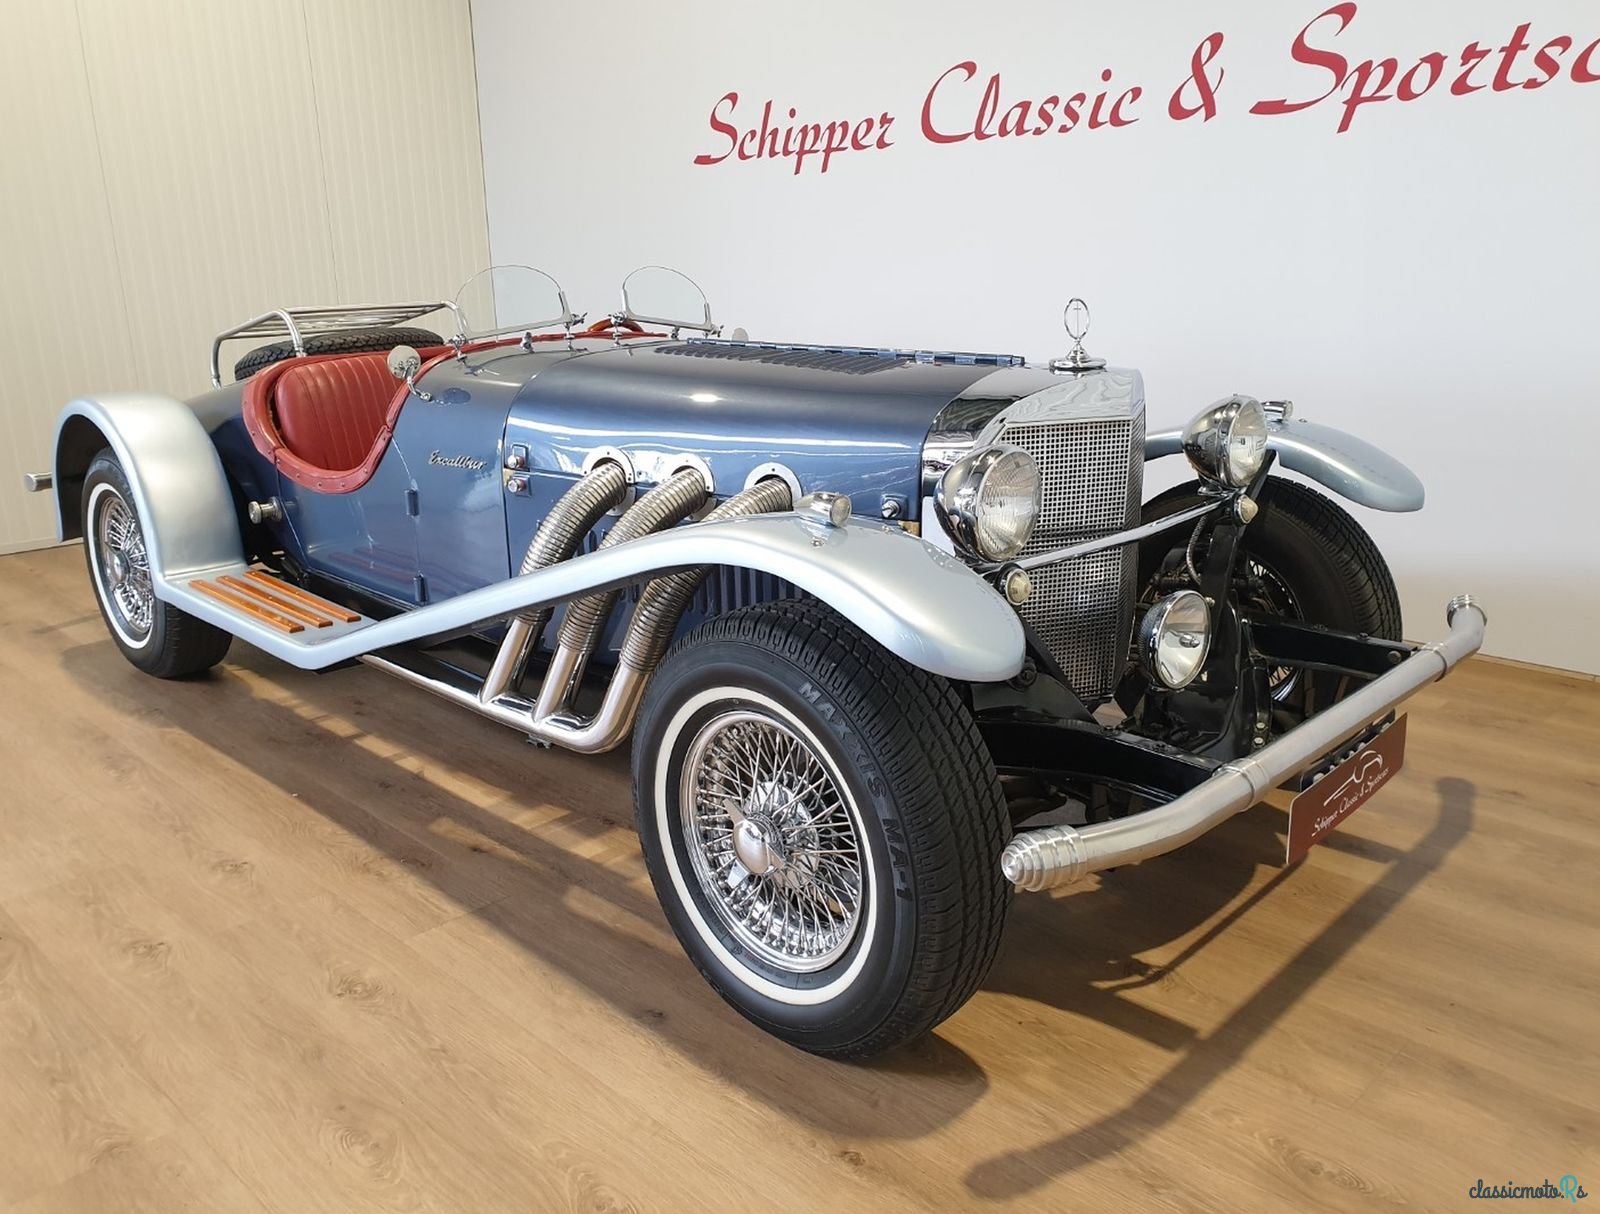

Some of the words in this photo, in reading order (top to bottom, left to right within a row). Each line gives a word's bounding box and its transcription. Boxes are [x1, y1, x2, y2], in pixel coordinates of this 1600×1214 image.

[693, 92, 895, 175] Schipper
[921, 61, 1141, 143] Classic
[1168, 32, 1225, 121] &
[428, 449, 487, 470] Excalibur
[800, 682, 888, 798] MAXXIS
[882, 817, 912, 901] MA-1
